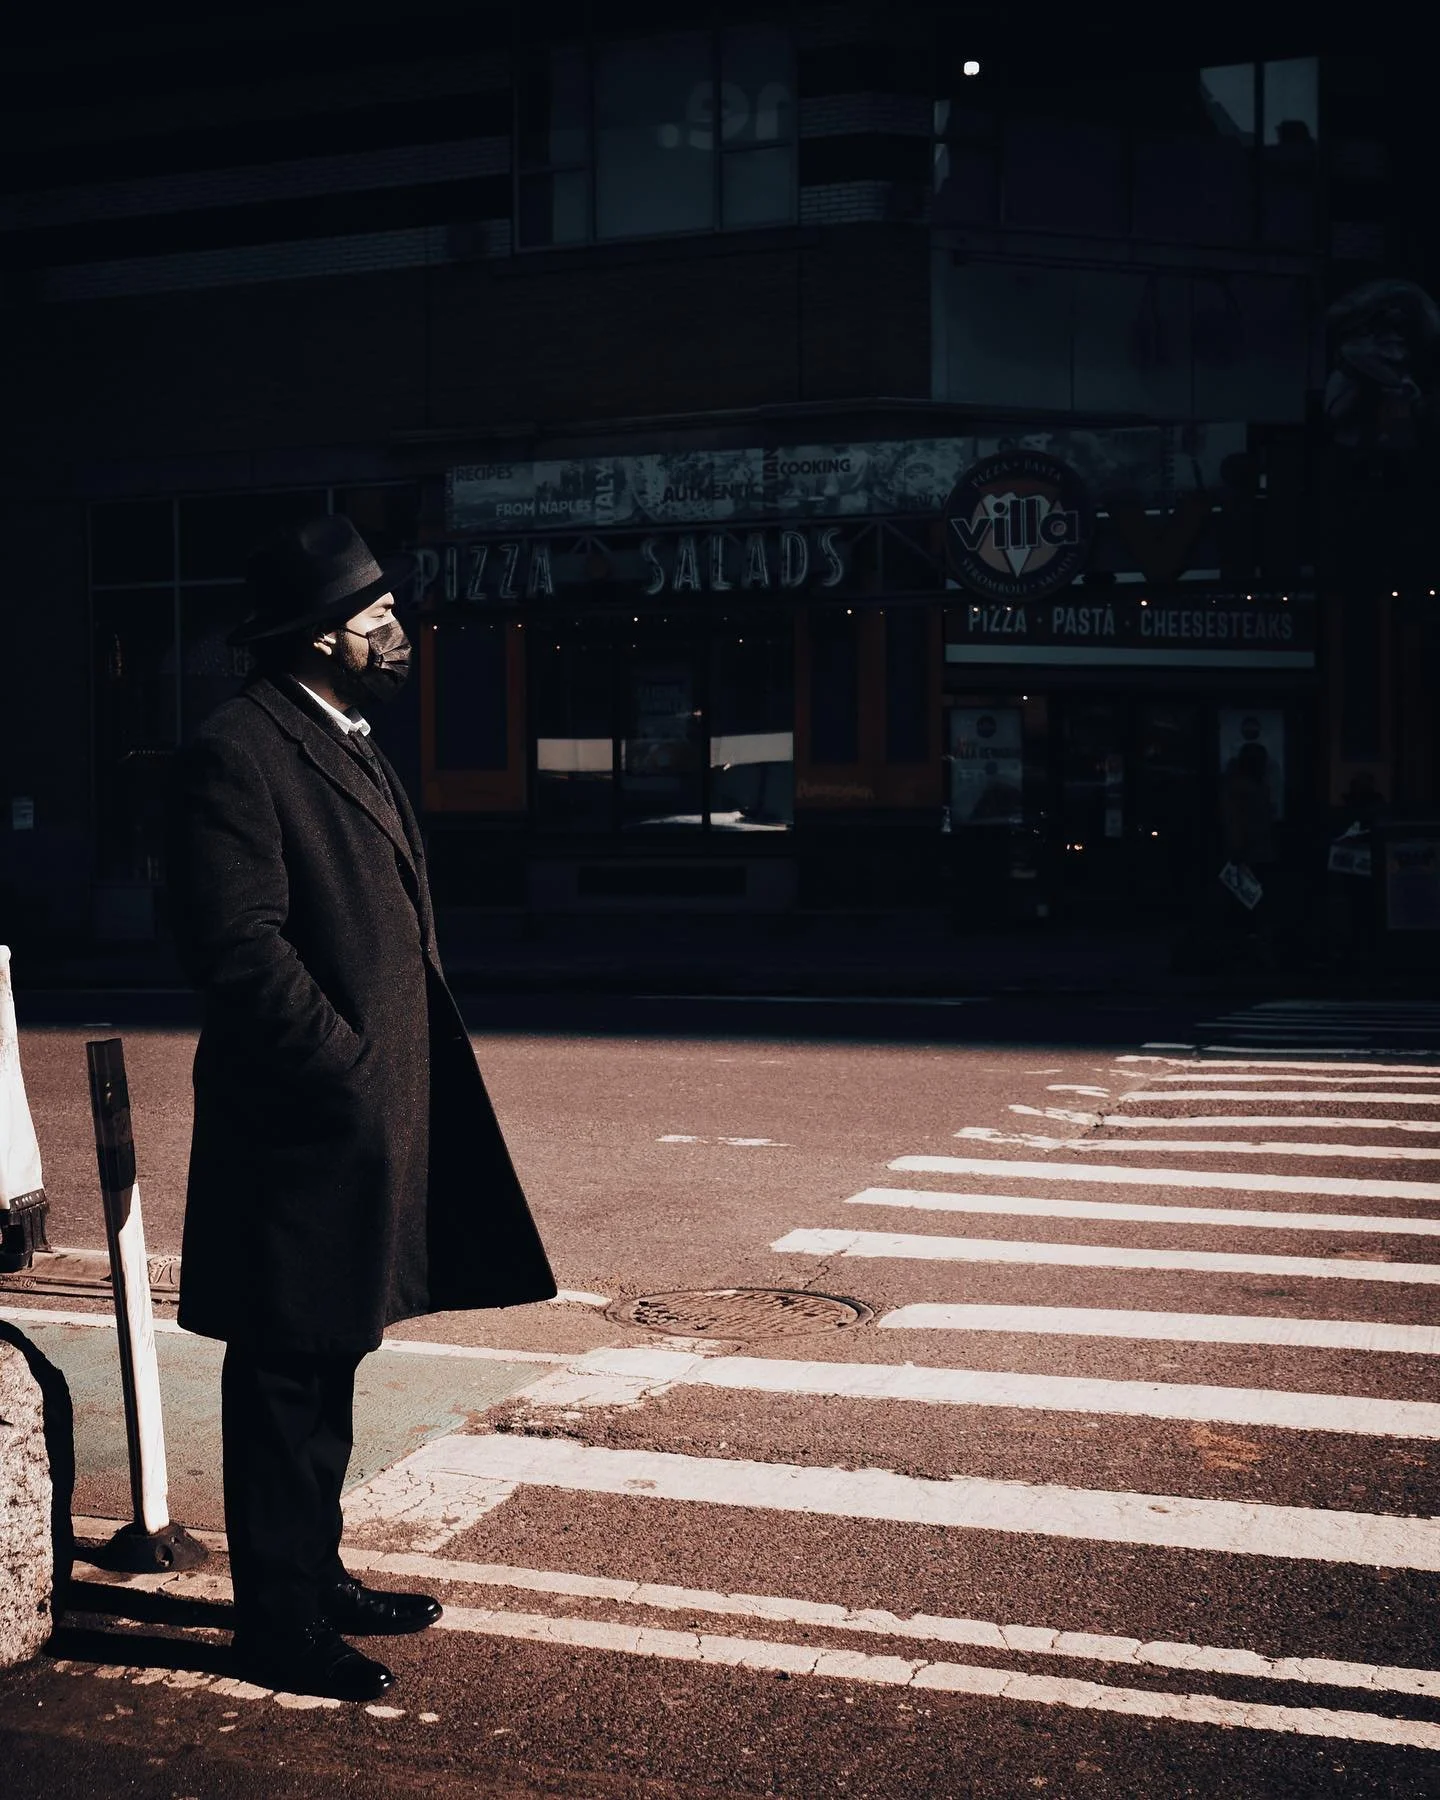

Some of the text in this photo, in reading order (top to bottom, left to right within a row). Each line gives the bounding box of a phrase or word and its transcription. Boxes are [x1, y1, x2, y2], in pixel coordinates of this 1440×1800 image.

[456, 466, 513, 482] RECIPES
[780, 459, 850, 475] COOKING
[496, 500, 592, 517] FROM NAPLES
[595, 463, 615, 526] ITALY
[950, 497, 1079, 551] villa
[414, 527, 845, 602] PIZZA SALADS
[968, 604, 1294, 640] PIZZA PASTA CHEESESTEAKS
